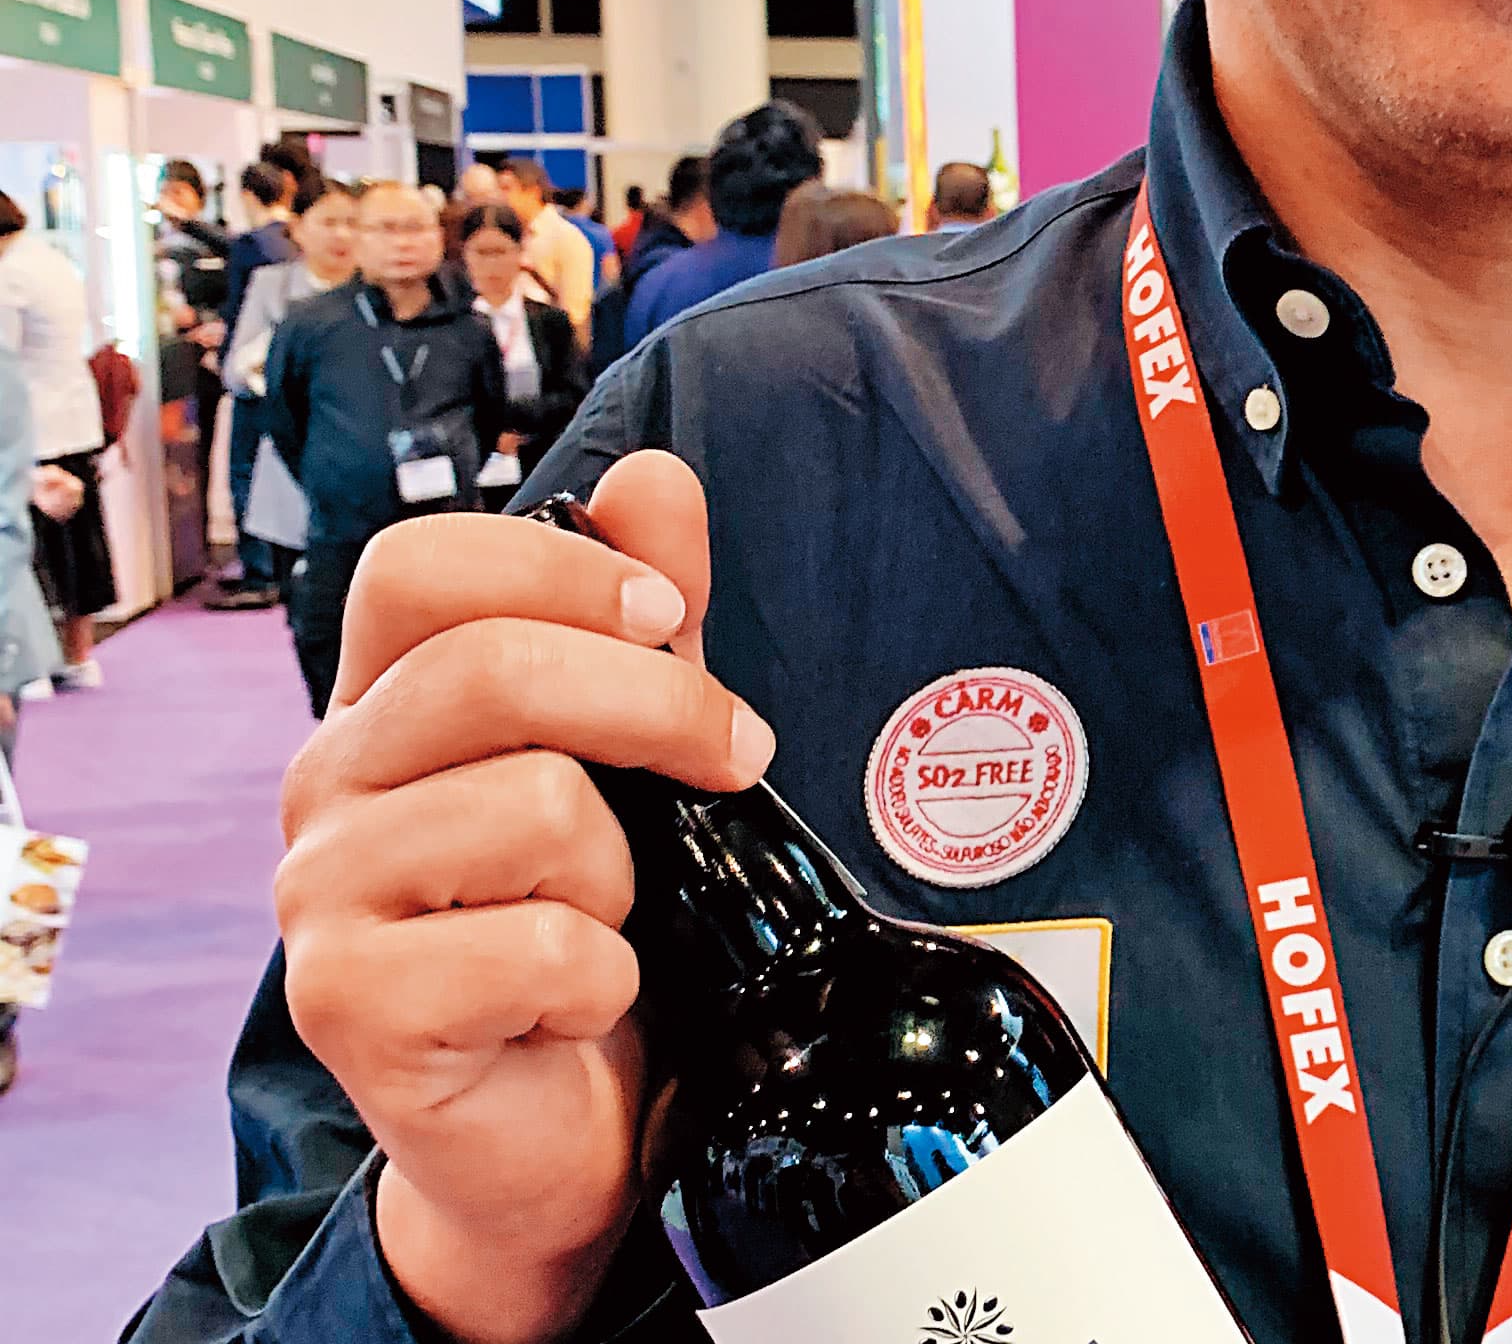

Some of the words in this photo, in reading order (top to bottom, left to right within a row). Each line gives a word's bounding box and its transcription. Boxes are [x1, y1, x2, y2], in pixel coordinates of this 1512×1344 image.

[1127, 223, 1197, 420] HOFEX
[934, 688, 1024, 719] CARM
[974, 759, 1034, 787] FREE
[1257, 876, 1356, 1125] HOFEX
